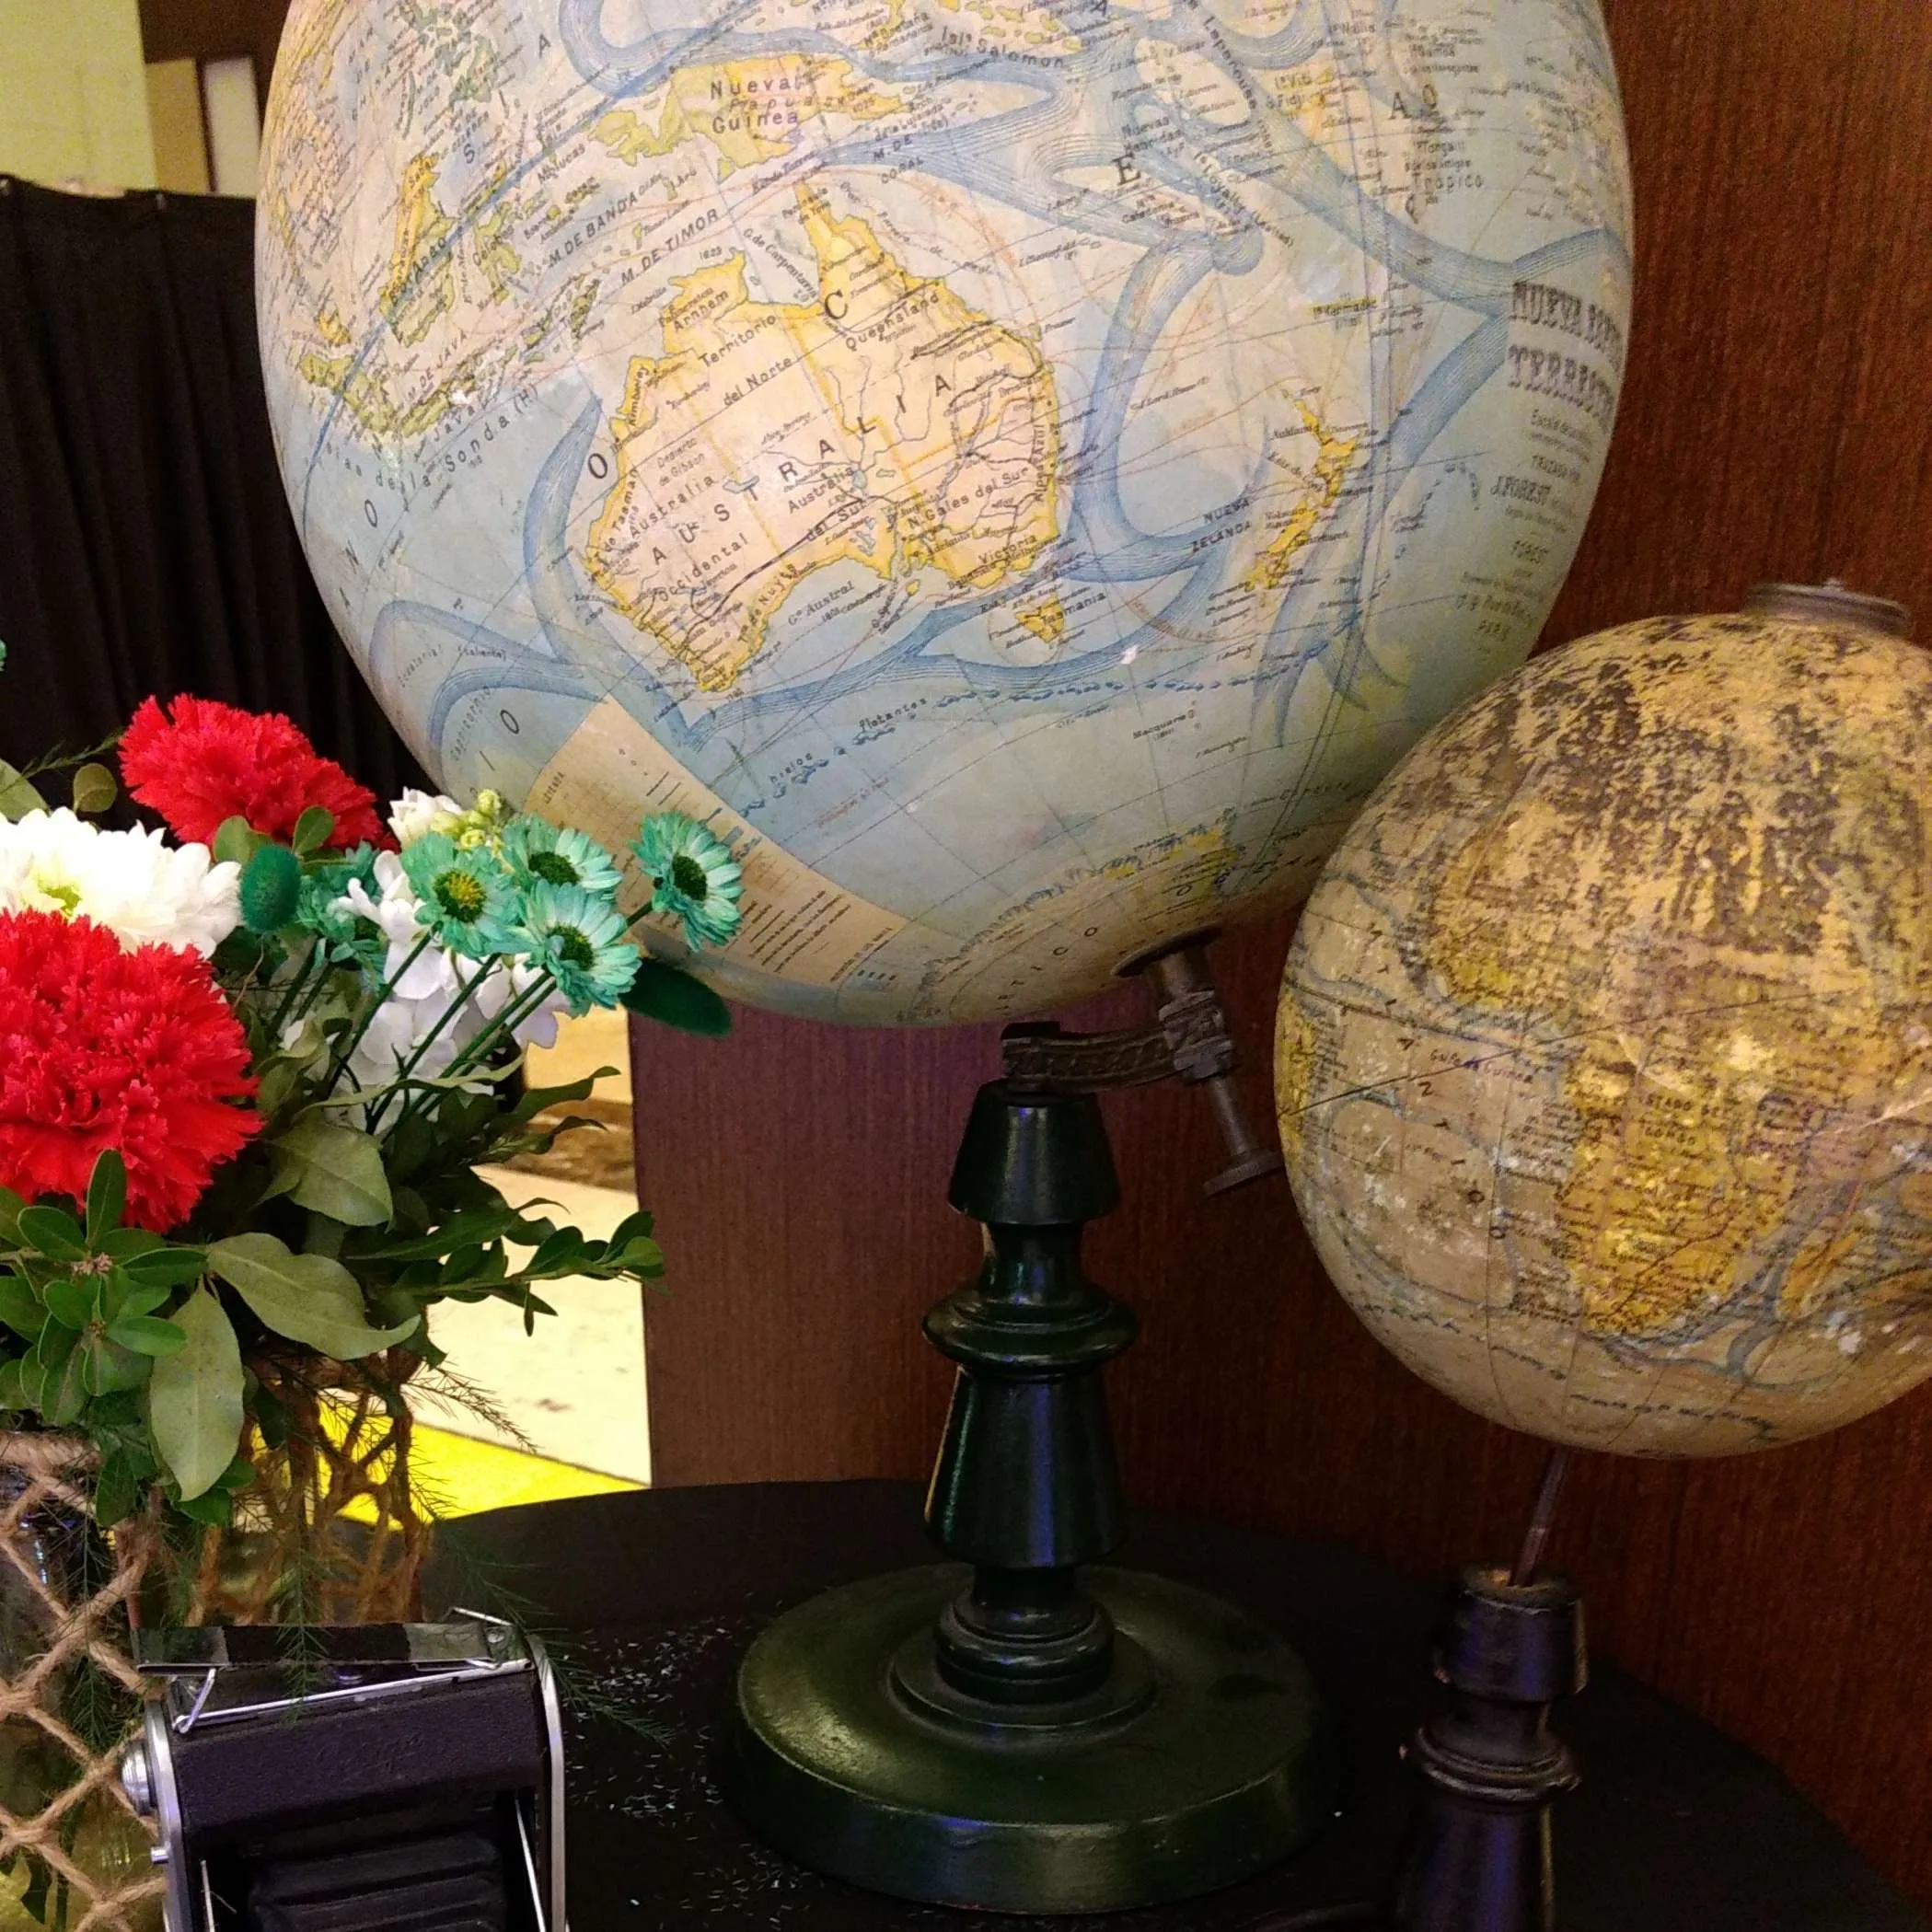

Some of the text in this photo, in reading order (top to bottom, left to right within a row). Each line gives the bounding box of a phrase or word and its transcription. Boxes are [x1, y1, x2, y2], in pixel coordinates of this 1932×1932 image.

[699, 312, 778, 368] Territorio
[845, 294, 940, 353] Queensland
[746, 356, 792, 391] Norte
